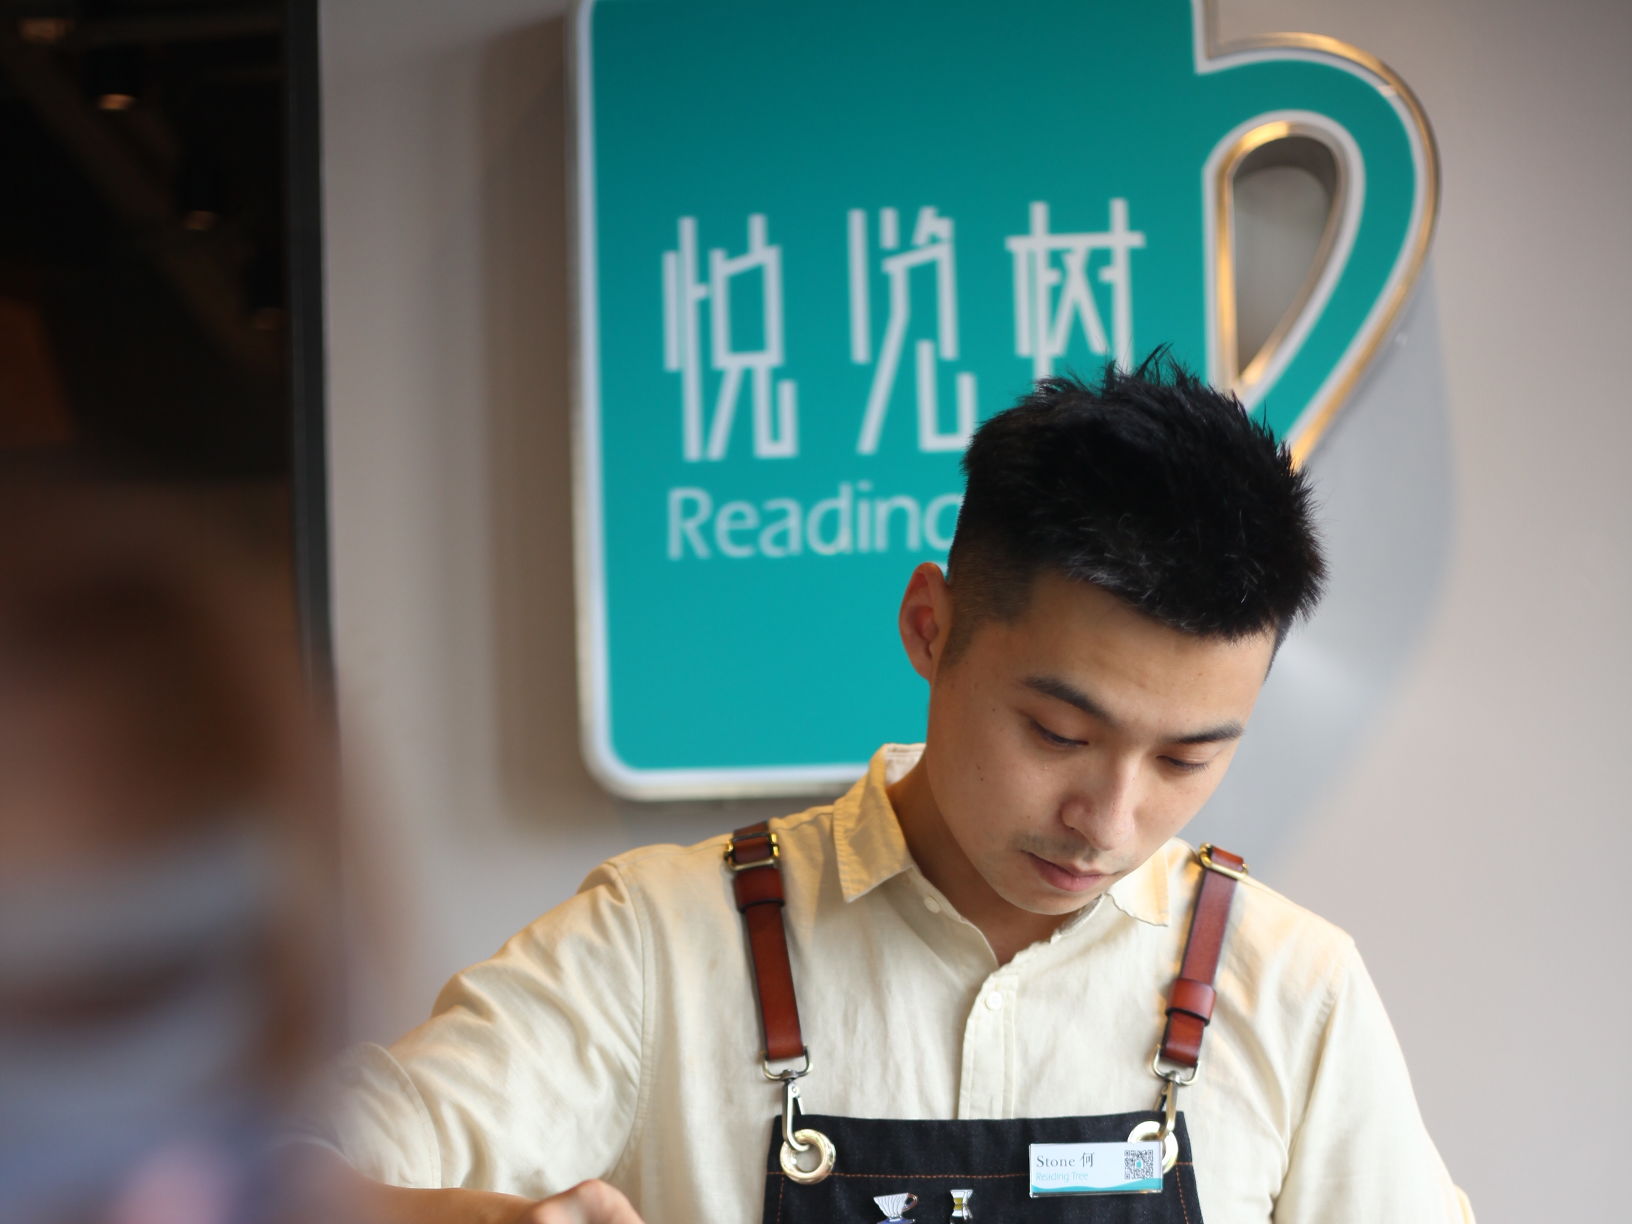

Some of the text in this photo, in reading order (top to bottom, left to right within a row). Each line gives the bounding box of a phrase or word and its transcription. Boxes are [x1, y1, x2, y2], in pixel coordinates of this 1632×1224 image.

[1036, 1152, 1094, 1168] Stone 何
[1036, 1171, 1088, 1183] Reading Tree
